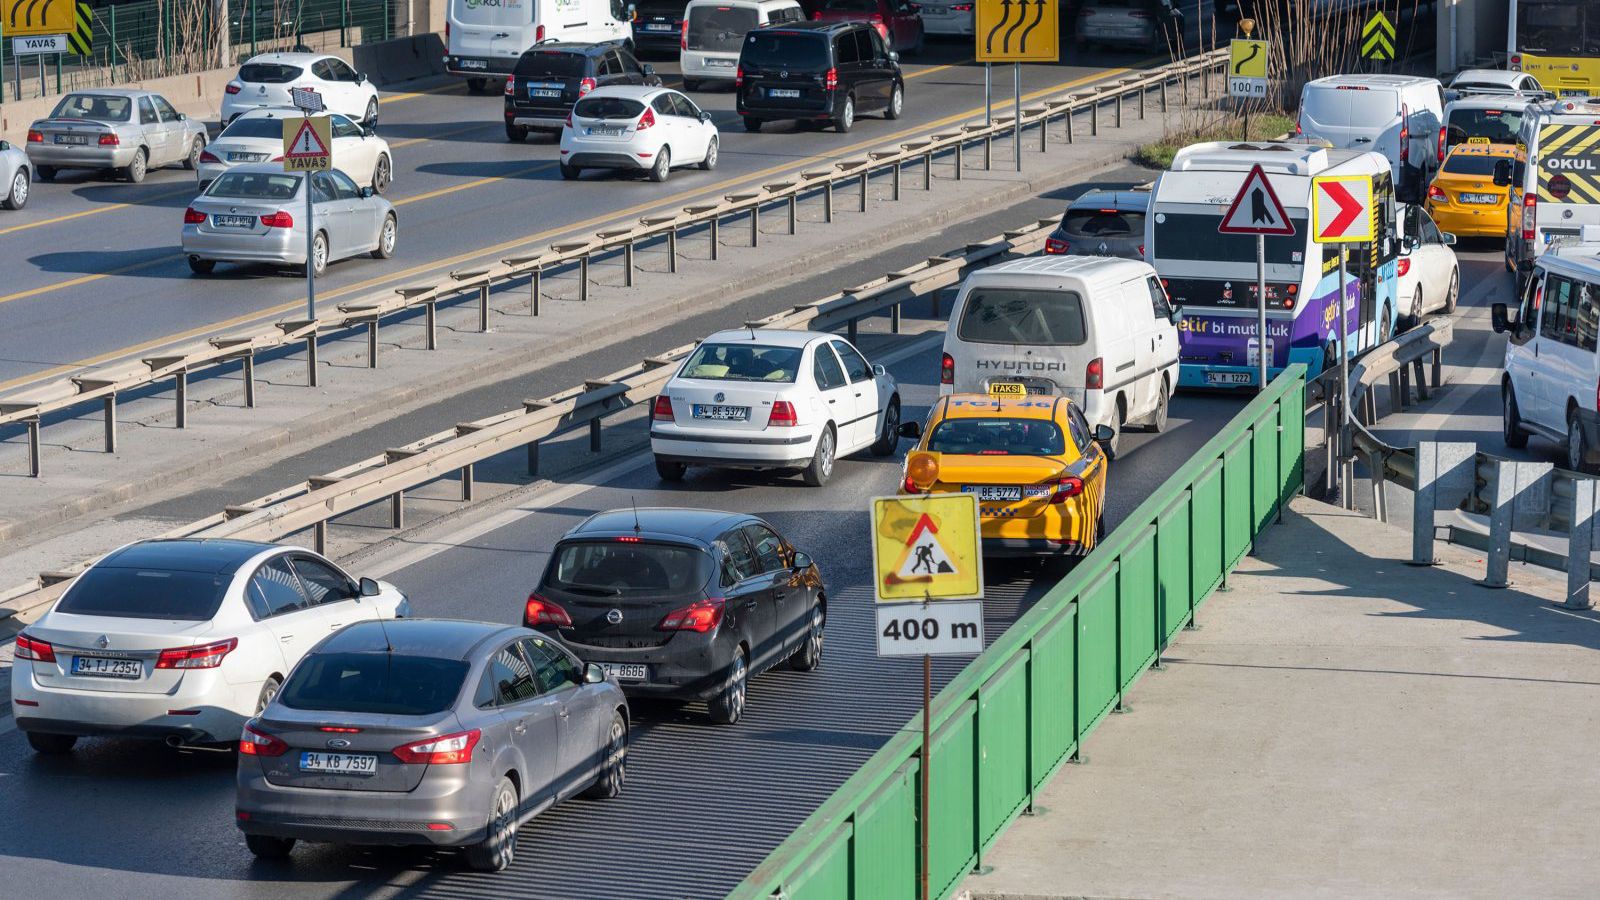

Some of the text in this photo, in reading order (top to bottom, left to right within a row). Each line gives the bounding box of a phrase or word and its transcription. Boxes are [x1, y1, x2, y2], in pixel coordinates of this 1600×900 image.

[25, 39, 56, 48] YAVAŞ
[1232, 82, 1264, 93] 100 m
[1547, 158, 1596, 170] OKUL
[1212, 322, 1225, 333] bi
[1228, 323, 1288, 337] mutlluk
[976, 359, 1066, 371] HYUNDAI
[1208, 373, 1217, 382] 34
[1232, 374, 1249, 383] 1222
[699, 406, 745, 416] 34 BE 5377
[982, 487, 993, 497] BE
[997, 488, 1019, 497] 5777
[882, 618, 978, 640] 400 m
[79, 658, 138, 674] 34 TJ 2354
[619, 665, 645, 677] 8686
[307, 753, 376, 770] 34 KB 7597
